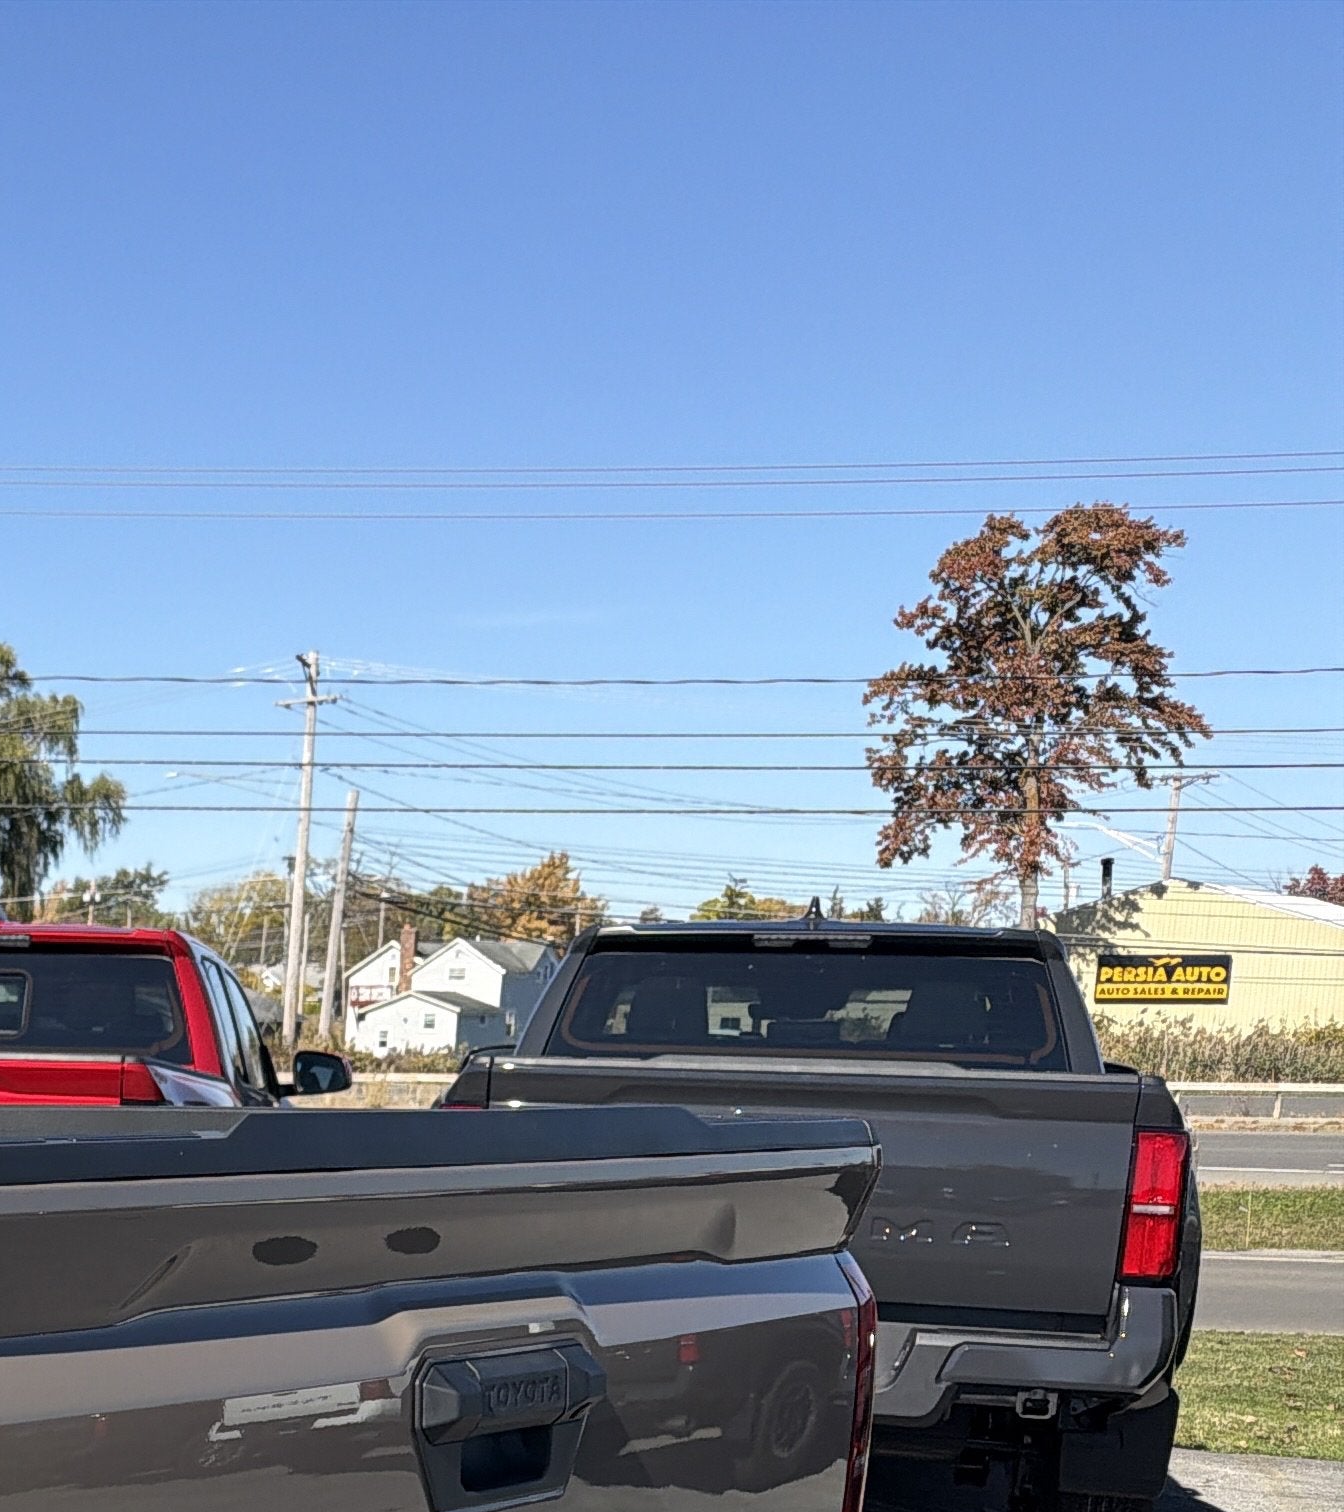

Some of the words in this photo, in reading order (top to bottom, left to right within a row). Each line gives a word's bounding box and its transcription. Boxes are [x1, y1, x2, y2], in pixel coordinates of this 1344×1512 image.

[1100, 966, 1167, 982] PERSIA
[1171, 966, 1227, 982] AUTO
[1098, 987, 1130, 996] AUTO
[1133, 987, 1166, 996] SALES
[1170, 987, 1180, 996] &
[1182, 987, 1225, 996] REPAIR
[480, 1375, 561, 1414] TOYOTA
